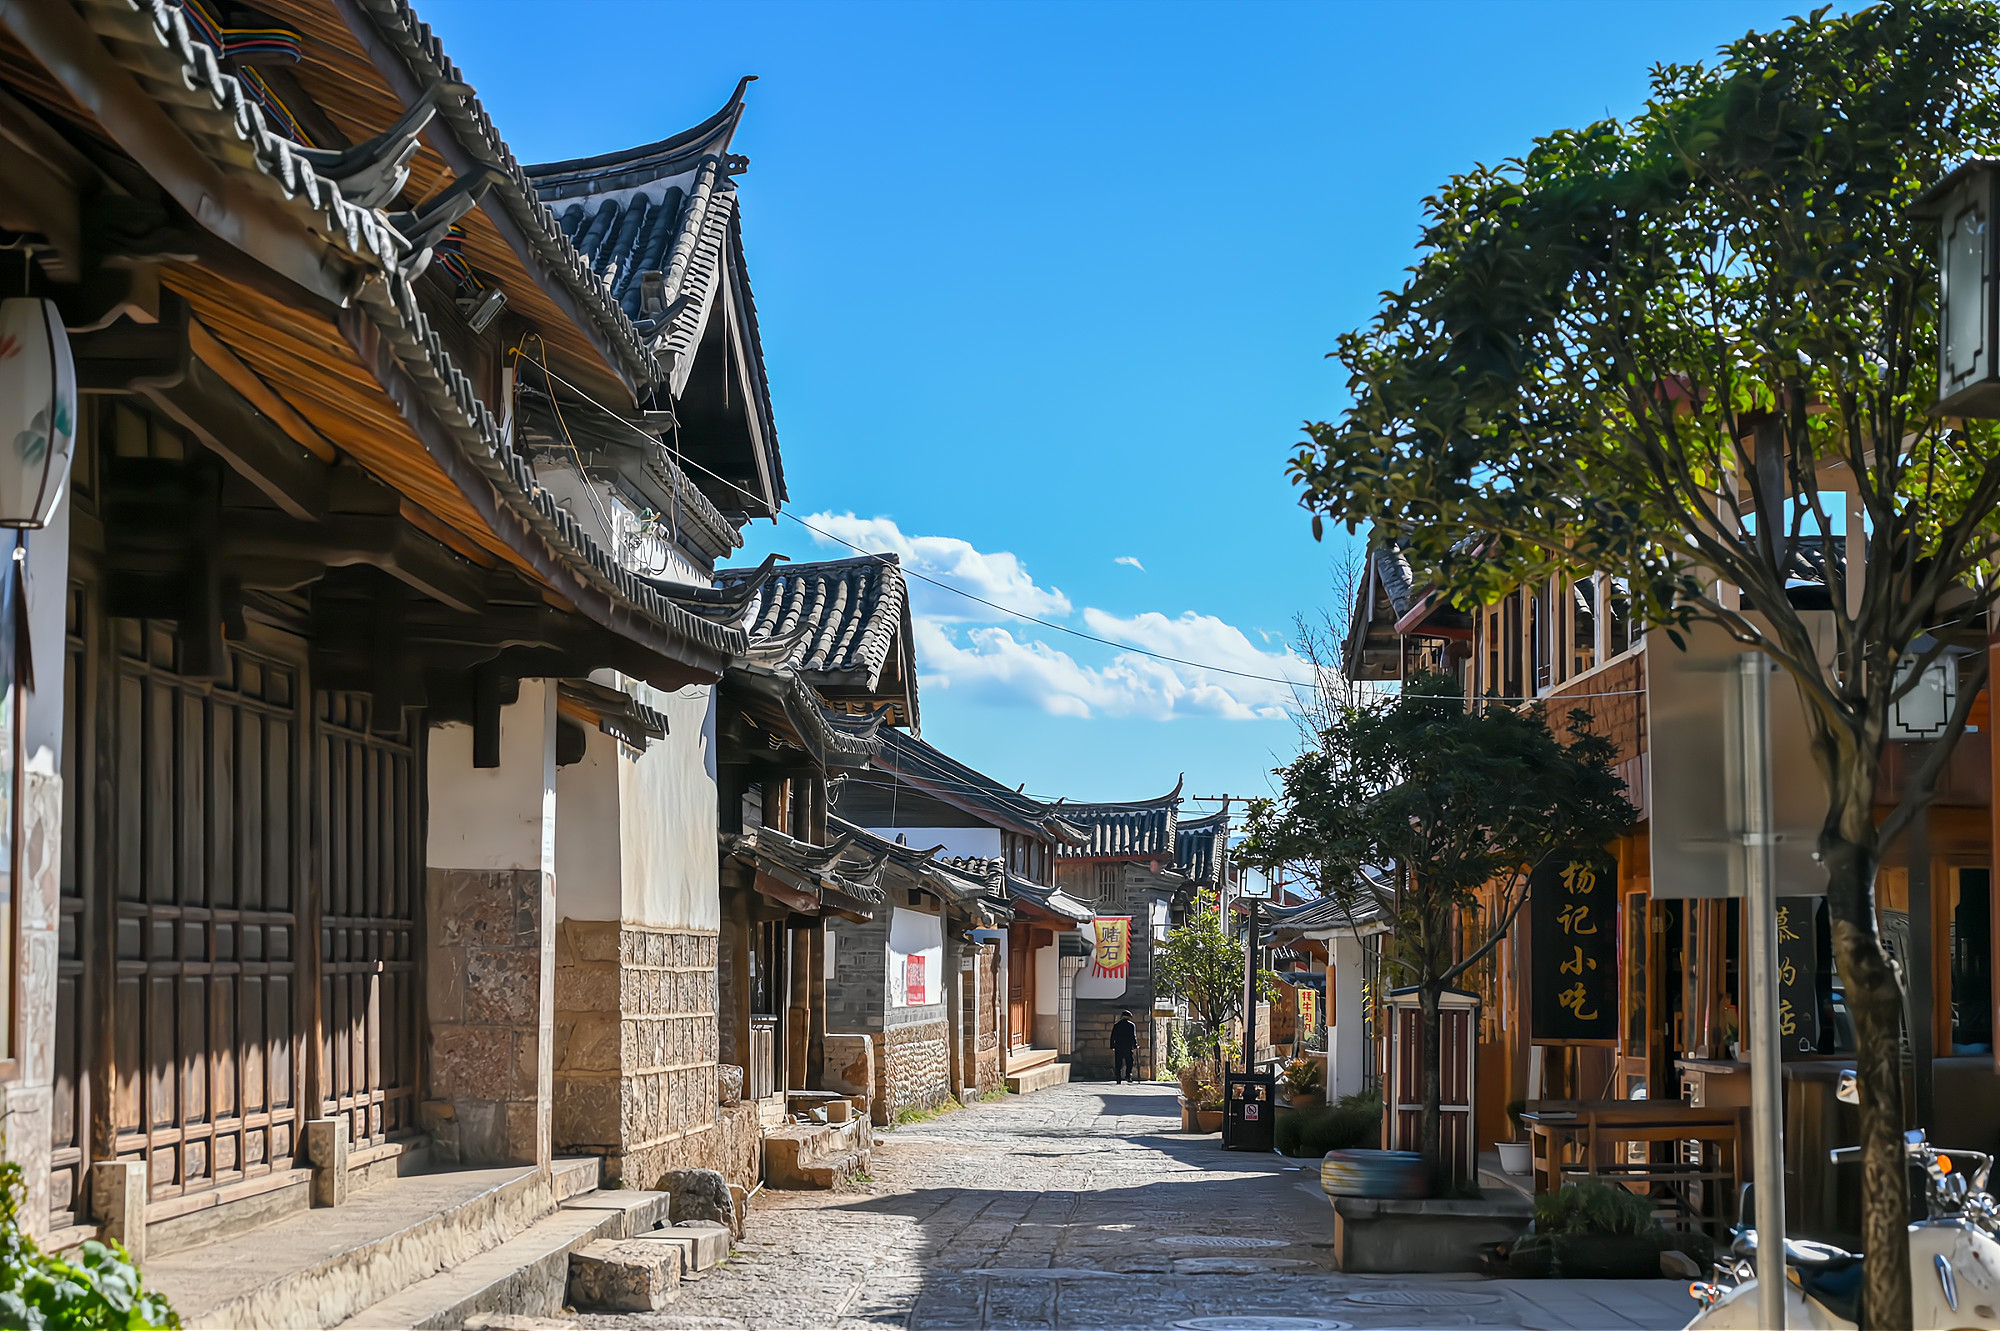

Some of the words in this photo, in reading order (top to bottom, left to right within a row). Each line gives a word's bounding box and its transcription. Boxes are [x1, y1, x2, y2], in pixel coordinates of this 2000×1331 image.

[1100, 926, 1121, 961] 赌石
[1556, 860, 1598, 1021] 杨记小吃
